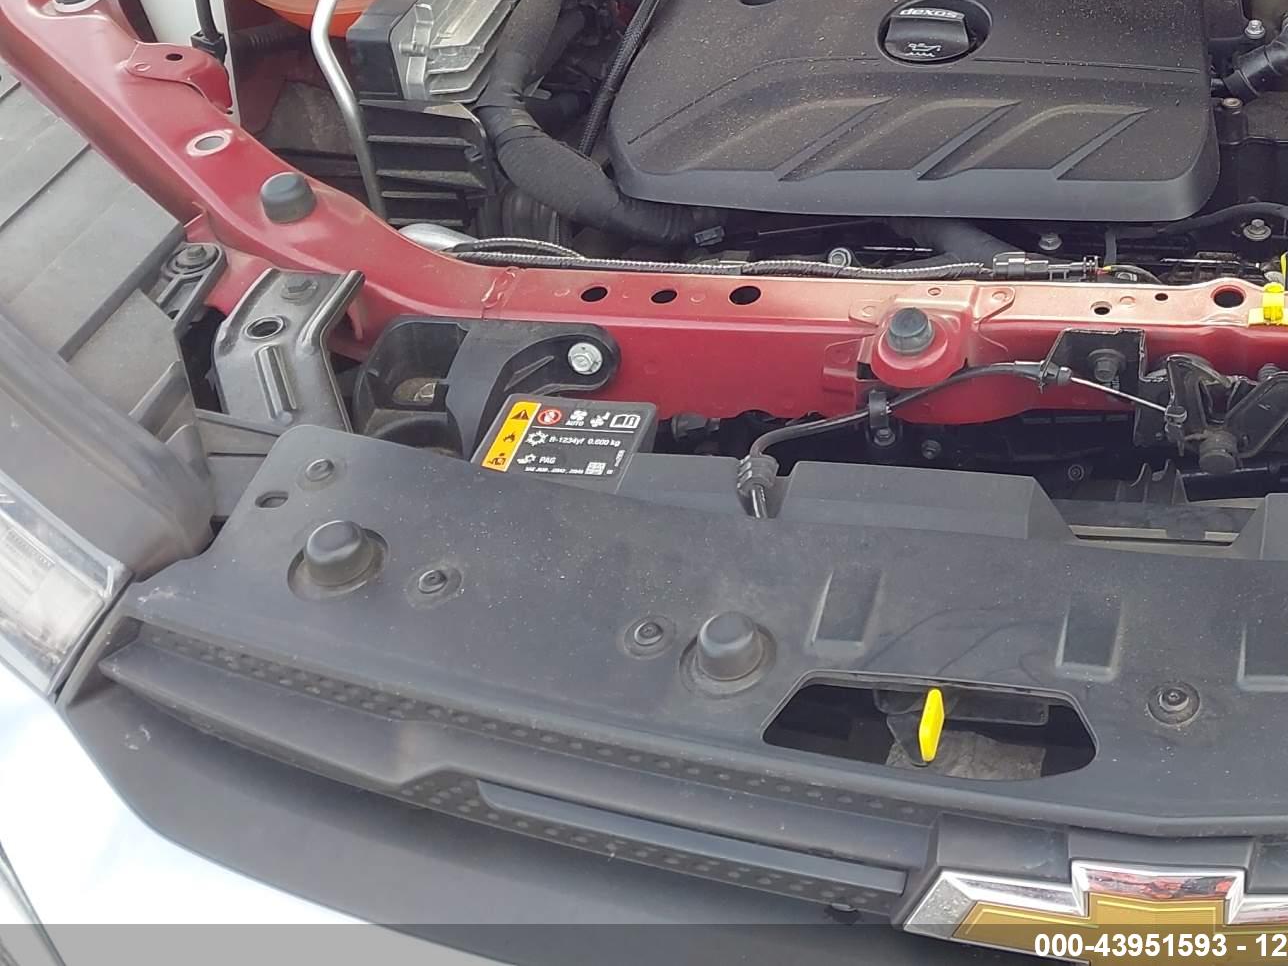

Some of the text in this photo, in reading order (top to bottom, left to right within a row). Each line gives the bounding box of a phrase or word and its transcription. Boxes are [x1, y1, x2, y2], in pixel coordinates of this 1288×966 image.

[899, 8, 957, 19] dexos
[549, 436, 585, 446] R-1234yf
[610, 439, 621, 448] kg
[539, 456, 556, 465] PAG
